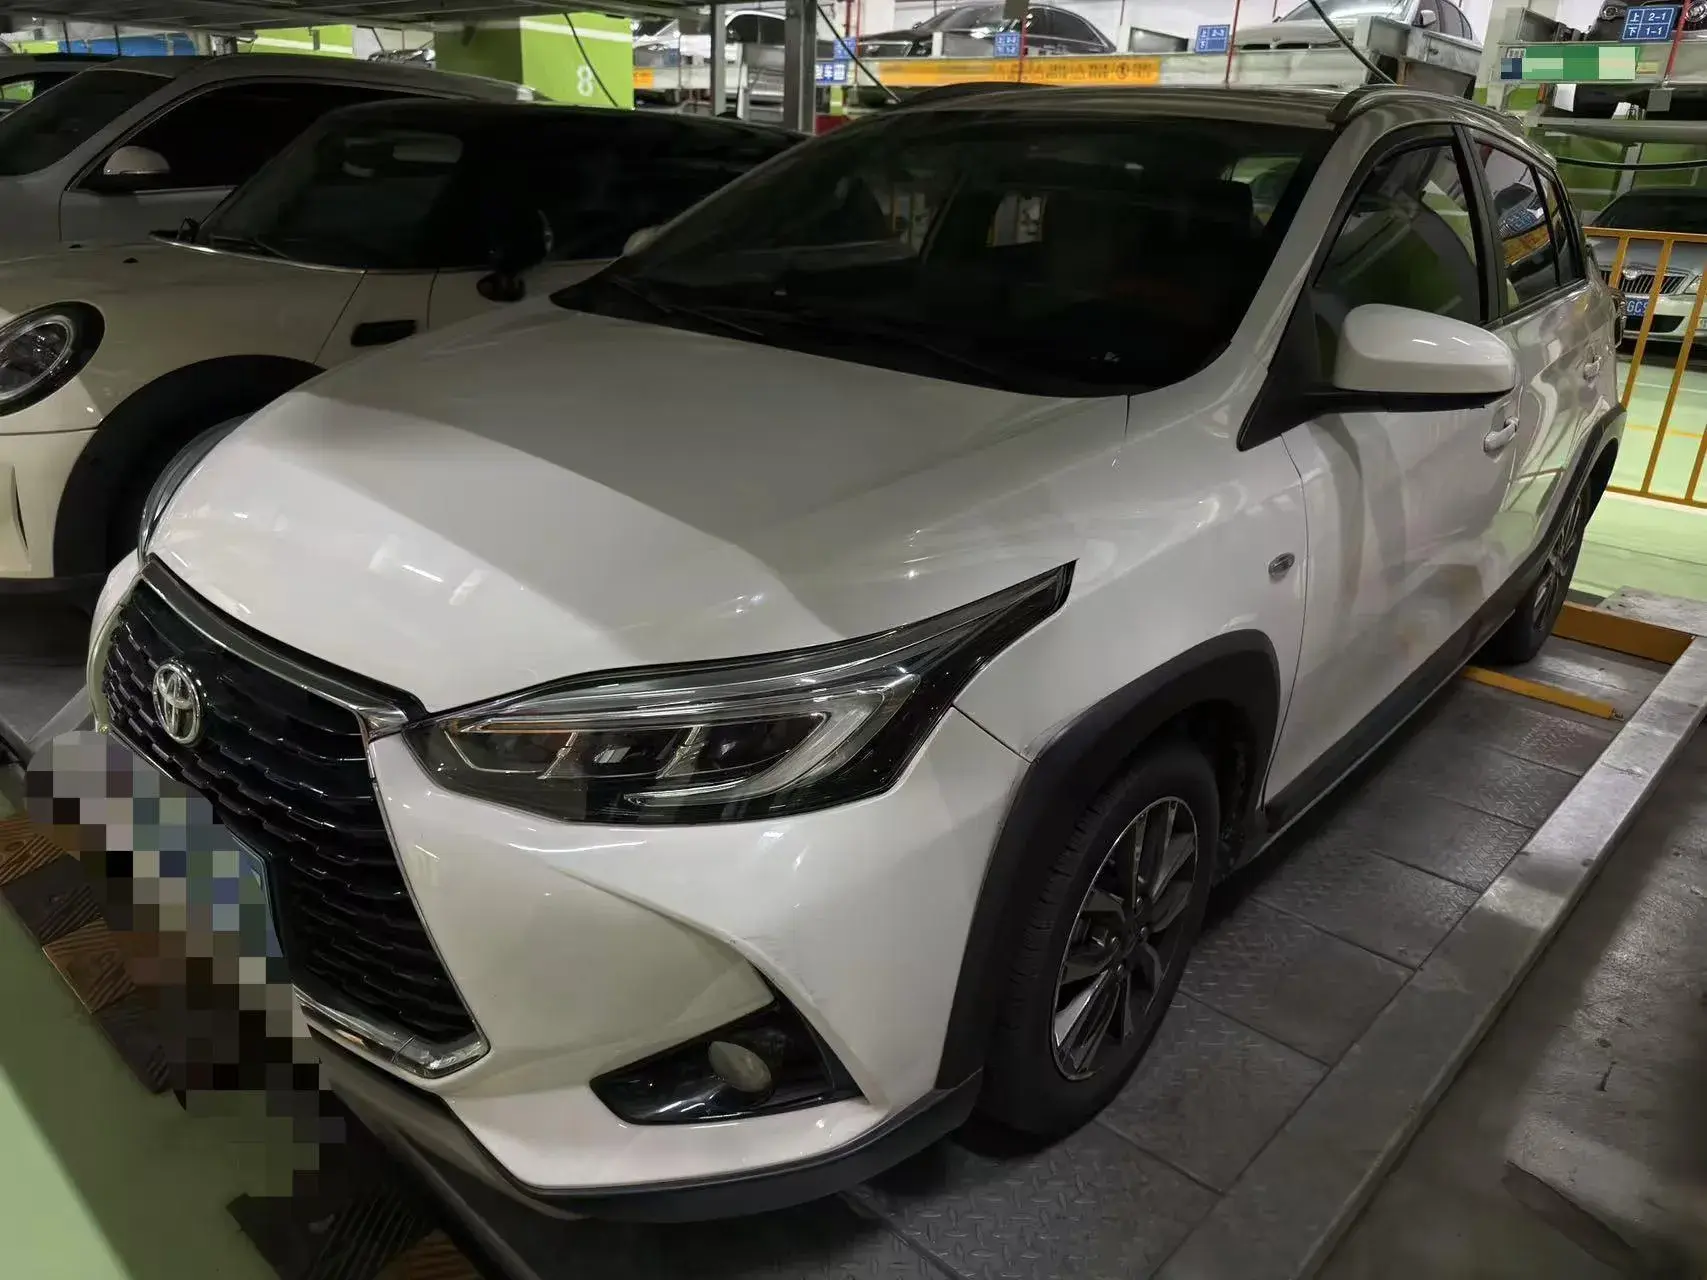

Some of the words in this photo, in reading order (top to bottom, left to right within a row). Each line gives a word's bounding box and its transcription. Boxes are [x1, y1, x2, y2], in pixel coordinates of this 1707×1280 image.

[1630, 12, 1640, 22] 上
[1648, 12, 1666, 21] 2-1
[1628, 26, 1638, 37] 下
[1646, 26, 1663, 35] 1-1
[576, 64, 594, 97] 8
